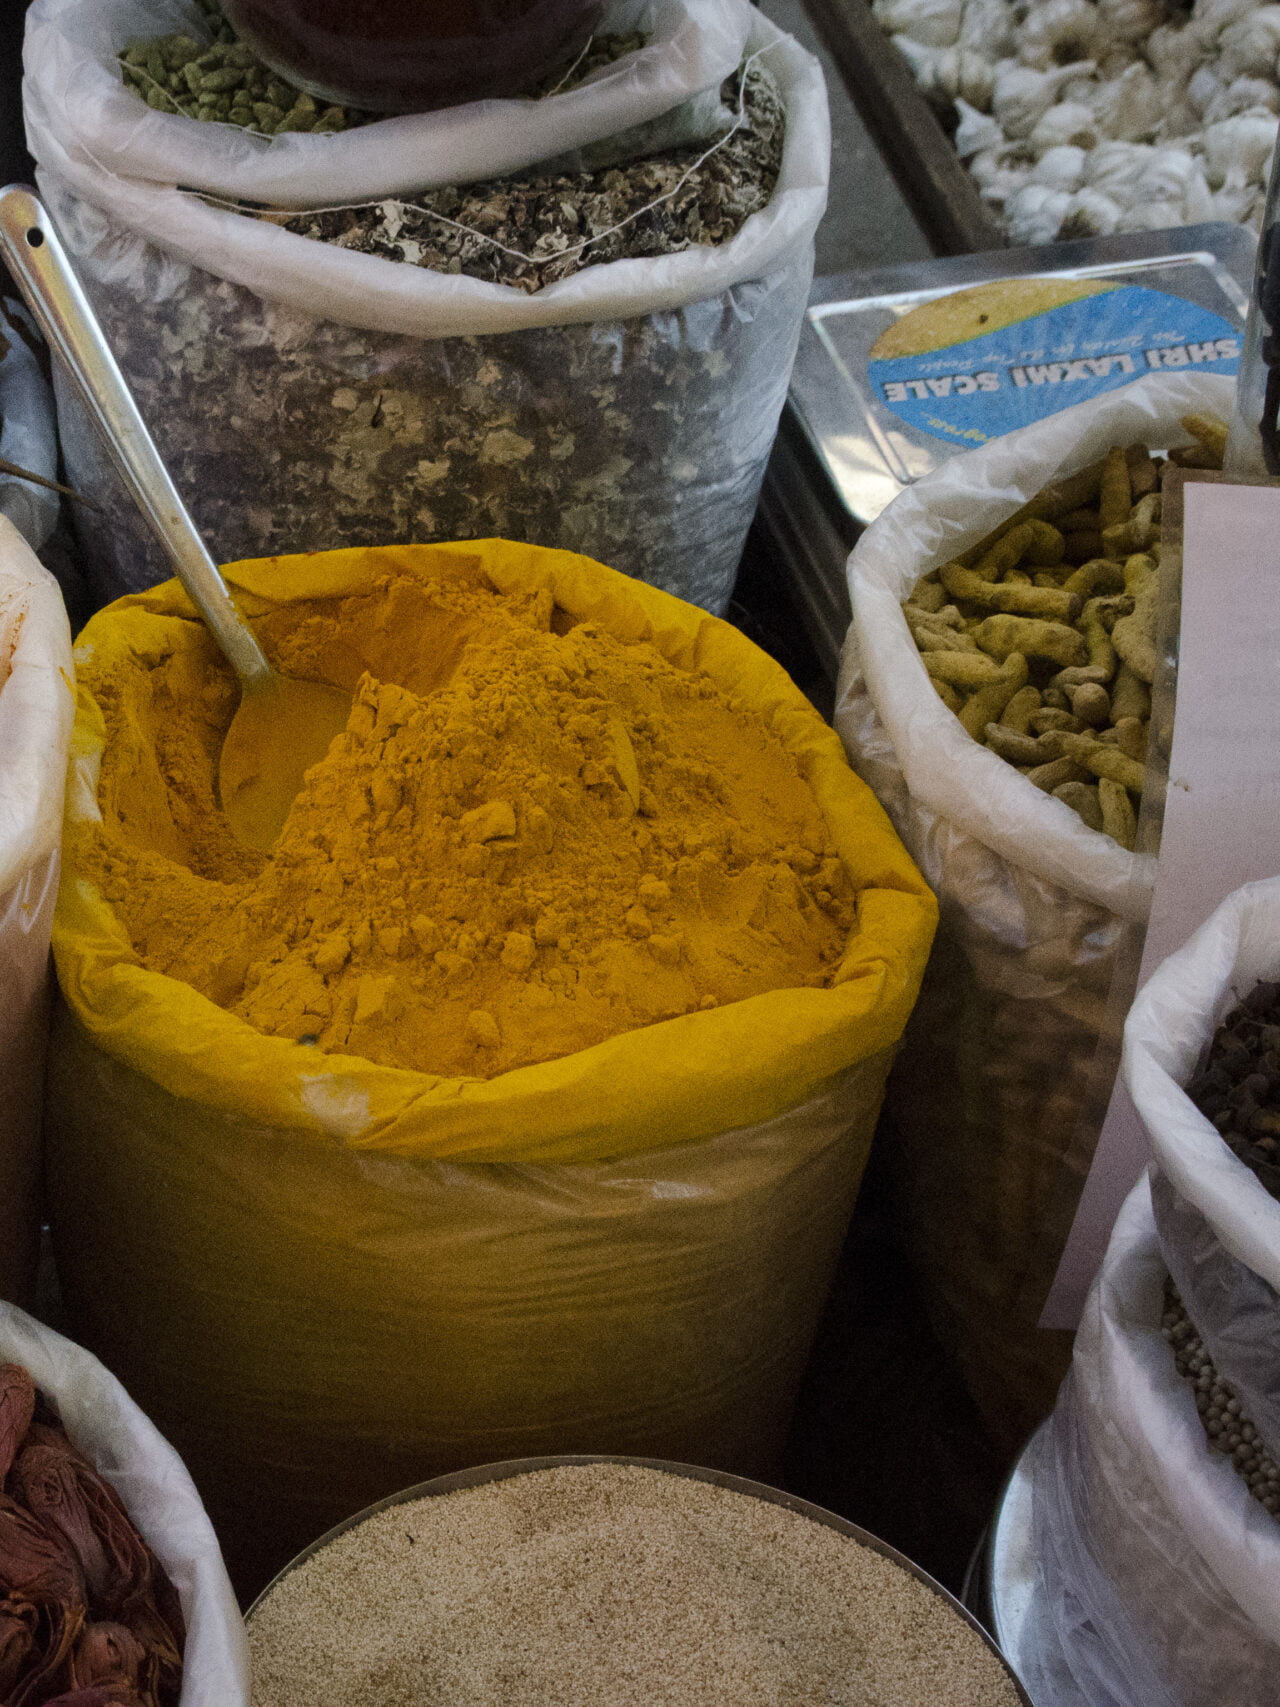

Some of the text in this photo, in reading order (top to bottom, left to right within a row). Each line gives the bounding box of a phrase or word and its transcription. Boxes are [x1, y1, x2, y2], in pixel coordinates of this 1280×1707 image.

[882, 338, 1241, 402] SHRI LAXMI SCALE
